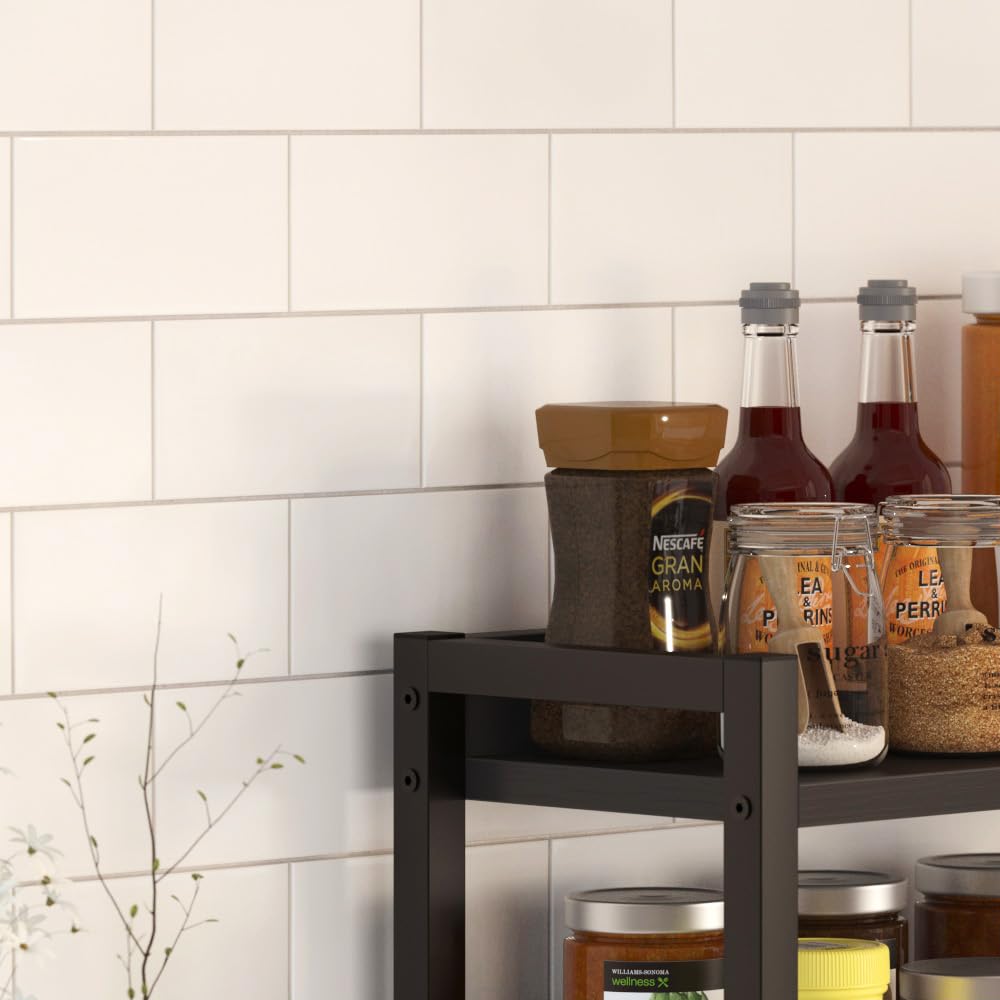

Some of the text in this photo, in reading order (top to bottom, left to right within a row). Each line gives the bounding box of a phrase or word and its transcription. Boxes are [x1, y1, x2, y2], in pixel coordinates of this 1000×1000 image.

[651, 554, 703, 576] GRAN
[649, 578, 702, 594] AROMA
[798, 577, 823, 595] EA
[931, 587, 938, 598] &
[802, 596, 811, 607] &
[895, 601, 948, 619] PERRI
[762, 608, 833, 627] PRINS
[612, 977, 656, 987] wellness
